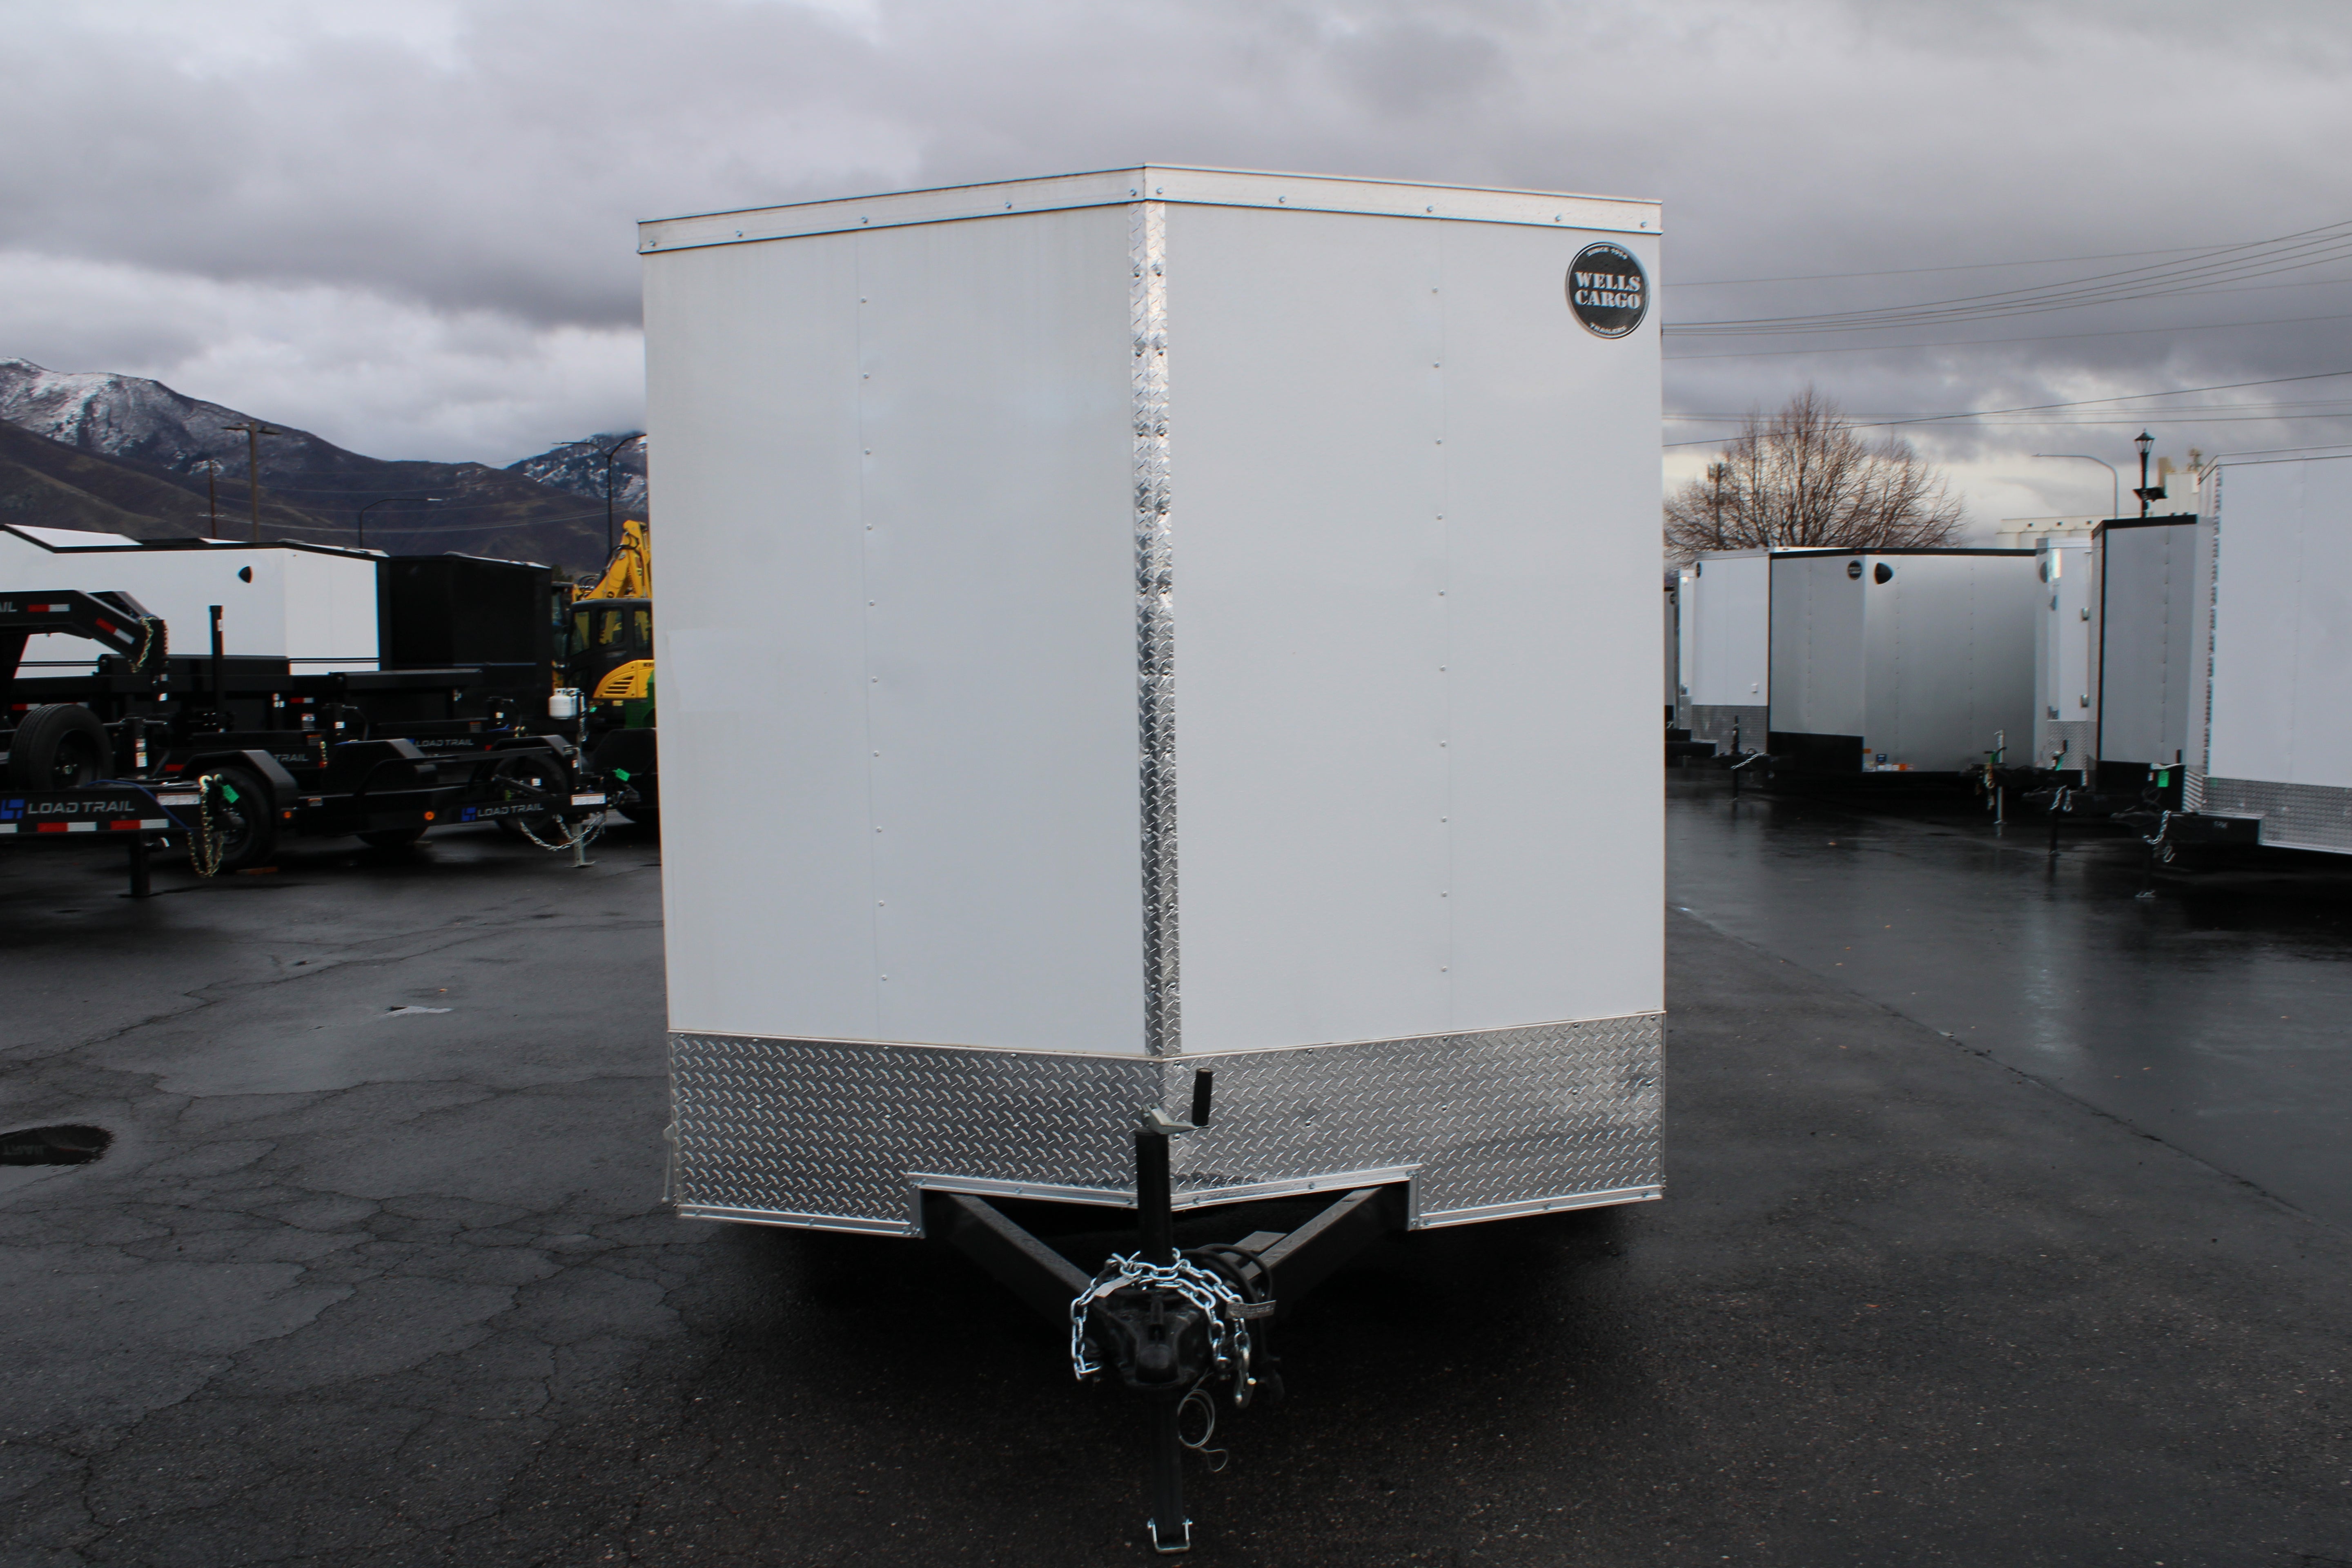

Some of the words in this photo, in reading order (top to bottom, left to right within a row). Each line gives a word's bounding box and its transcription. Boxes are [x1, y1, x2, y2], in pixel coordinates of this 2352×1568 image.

[1575, 272, 1641, 292] WELLS
[1575, 290, 1641, 309] CARGO
[27, 802, 80, 814] LOAD
[82, 801, 135, 813] TRAIL
[477, 807, 509, 817] LOAD
[511, 803, 545, 813] TRAIL
